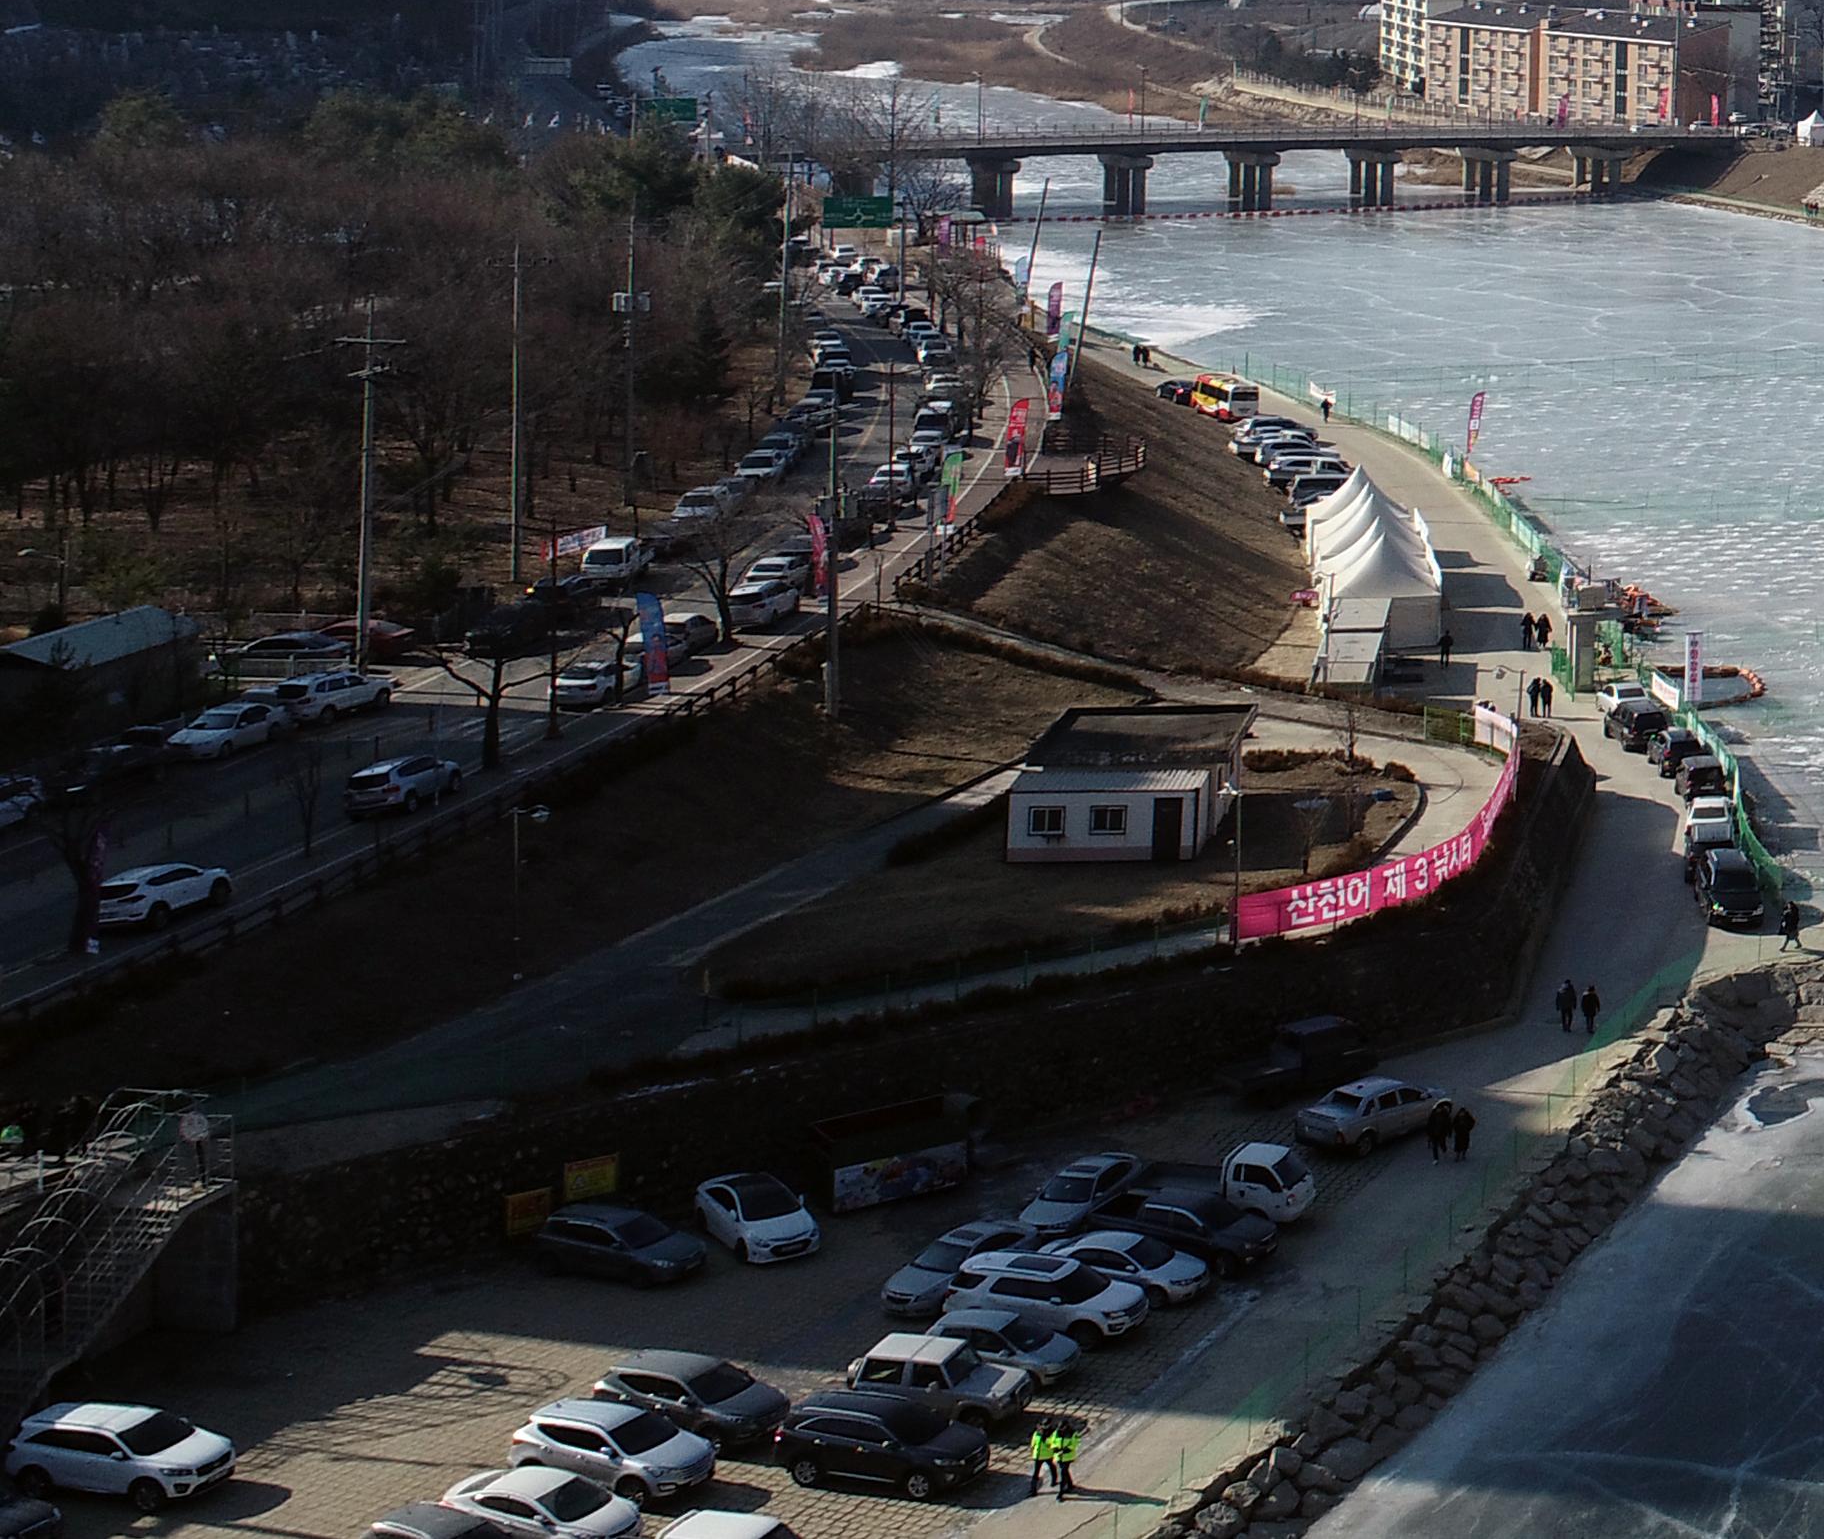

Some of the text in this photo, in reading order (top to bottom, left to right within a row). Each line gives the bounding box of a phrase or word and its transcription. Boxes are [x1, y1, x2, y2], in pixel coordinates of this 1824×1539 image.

[1287, 832, 1472, 926] 산천어 제 3 낚시터
